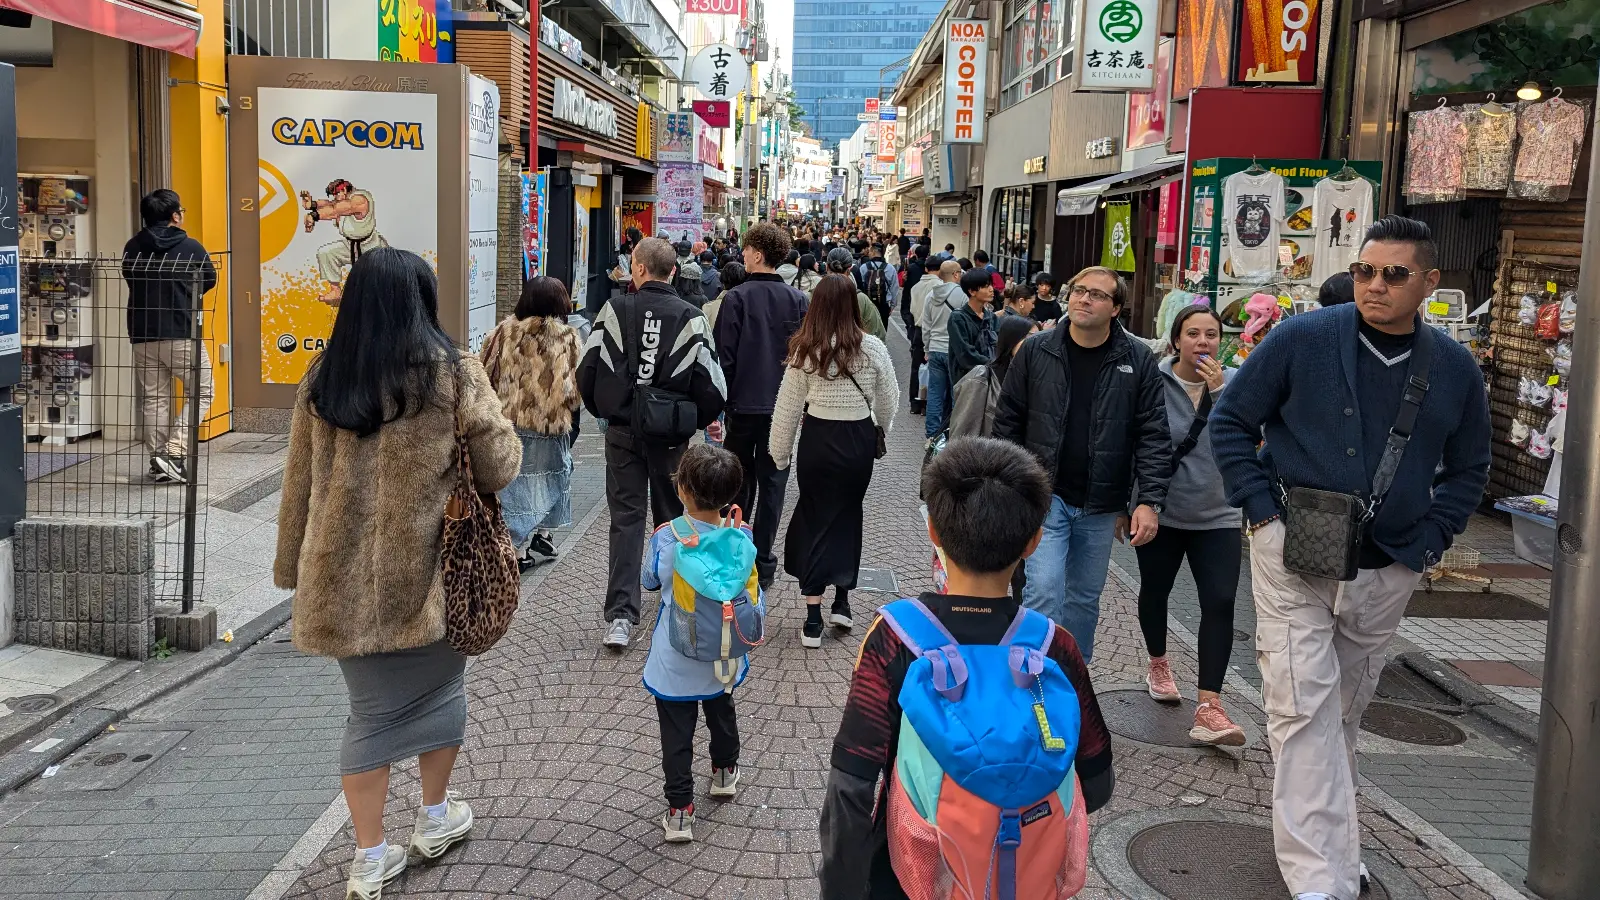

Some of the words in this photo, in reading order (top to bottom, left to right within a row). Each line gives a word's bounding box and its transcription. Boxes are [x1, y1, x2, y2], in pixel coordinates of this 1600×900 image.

[951, 23, 985, 38] NOA
[1086, 49, 1145, 69] 吉茶庵
[709, 47, 732, 97] 古着
[352, 74, 392, 92] Blau
[396, 76, 429, 93] 原宿
[955, 45, 976, 139] COFFEE
[239, 96, 253, 110] 3
[272, 117, 424, 150] CAPCOM
[885, 124, 896, 150] NOA
[1270, 166, 1297, 177] Food
[1299, 166, 1328, 178] Floor
[240, 198, 254, 212] 2
[245, 291, 252, 304] 1
[303, 338, 325, 351] CA
[951, 606, 992, 614] DEUTSCHLAND
